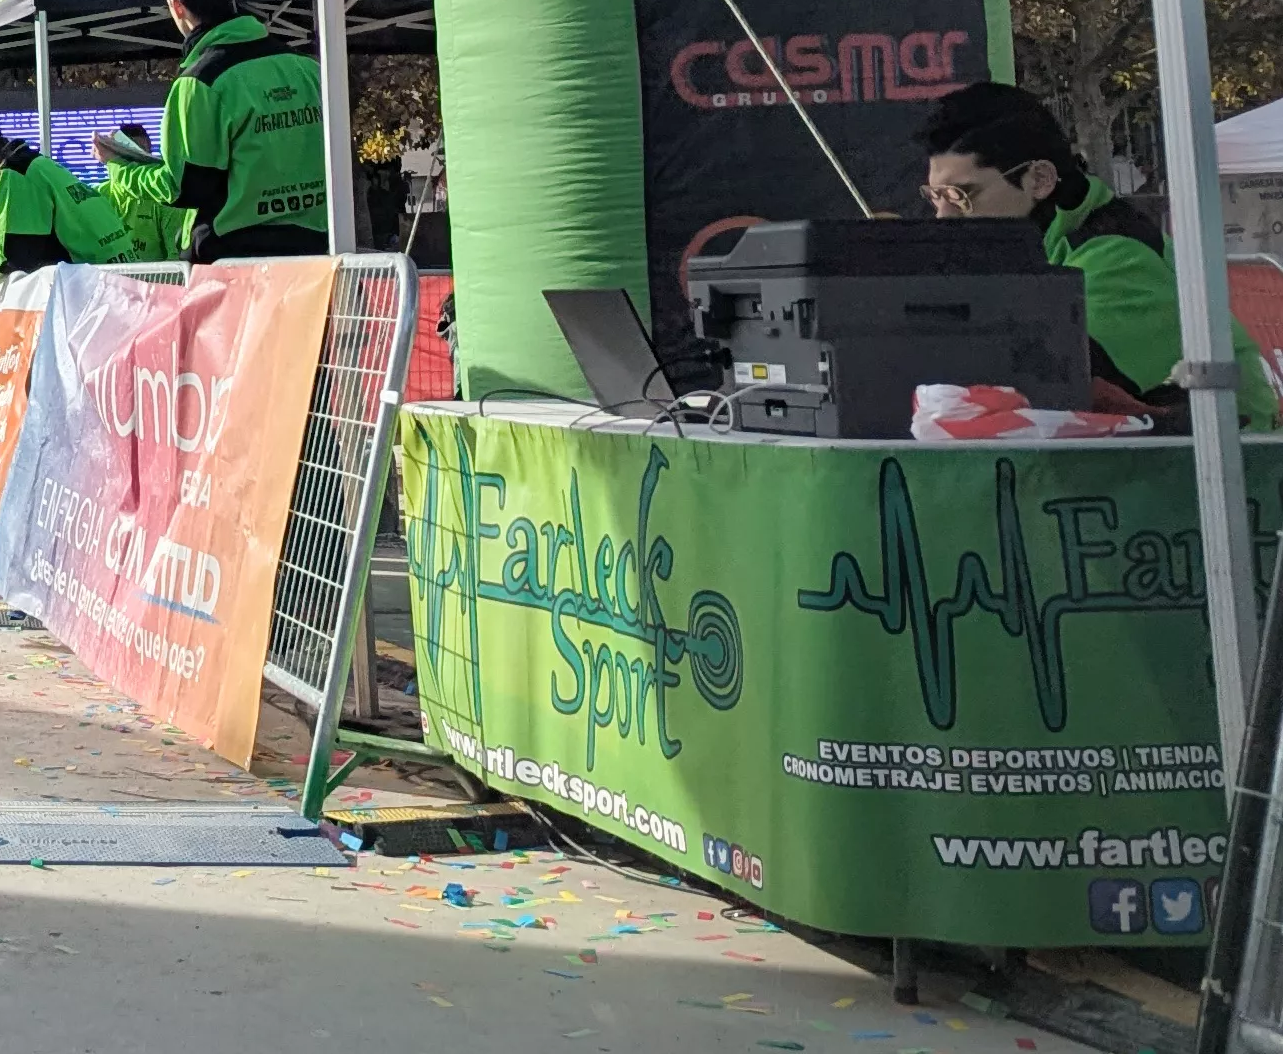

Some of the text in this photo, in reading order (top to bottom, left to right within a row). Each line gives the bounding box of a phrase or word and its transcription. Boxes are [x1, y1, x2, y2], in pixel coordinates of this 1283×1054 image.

[474, 443, 675, 631] Farleck
[551, 586, 683, 771] Sport
[782, 754, 1227, 795] CRONOMETRAJE EVENTOS ANIMACIO
[818, 740, 943, 767] EVENTOS
[951, 747, 1116, 770] DEPORTIVOS
[933, 829, 1229, 869] www.fartlec
